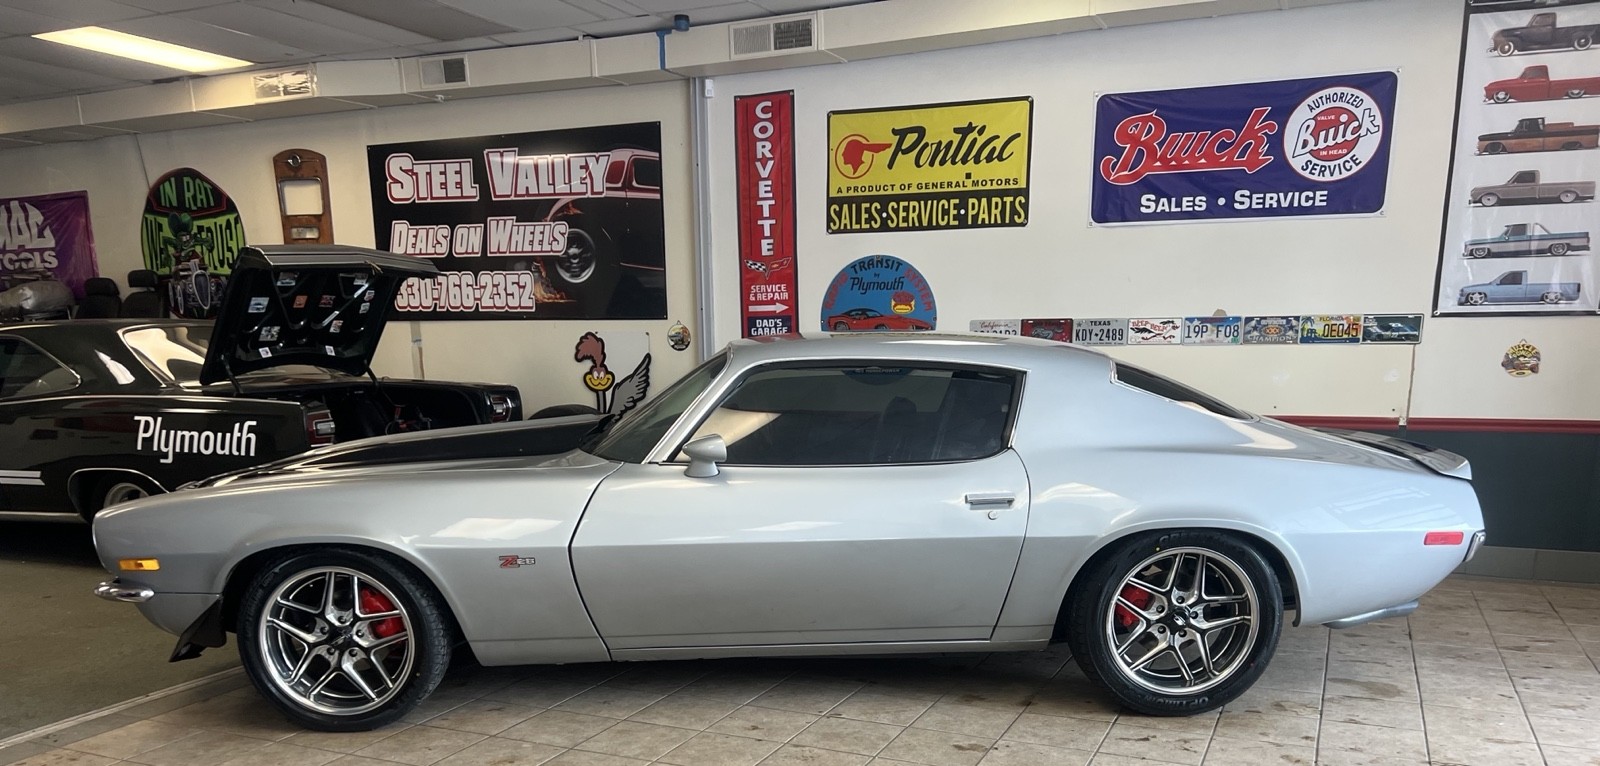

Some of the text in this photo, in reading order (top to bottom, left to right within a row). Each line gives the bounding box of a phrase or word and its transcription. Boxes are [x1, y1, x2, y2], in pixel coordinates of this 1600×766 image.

[1307, 92, 1364, 113] AUTHORIZED
[1292, 108, 1380, 158] Buick
[887, 121, 1022, 170] Pontiac
[1100, 107, 1278, 186] Buick
[385, 148, 611, 204] STEEL VALLEY
[1301, 154, 1362, 177] SERVICE
[752, 101, 777, 256] CORVETTE
[846, 184, 896, 193] PRODUCT
[900, 183, 913, 191] OF
[916, 180, 967, 190] GENERAL
[971, 178, 1019, 188] MOTORS
[160, 176, 215, 210] IN RAT
[1140, 189, 1328, 214] SALES SERVICE
[829, 195, 1026, 230] SALES SERVICE PARTS
[390, 216, 569, 258] DEALS ON WHEELS
[850, 258, 903, 275] TRANSIT
[750, 292, 789, 301] & REPAIR
[751, 284, 787, 293] SERVICE
[850, 276, 906, 295] Plymouth
[751, 327, 788, 335] GARAGE
[756, 318, 782, 328] DAD'S
[1185, 325, 1208, 338] 19P
[134, 415, 257, 464] Plymouth
[499, 554, 536, 568] Z28
